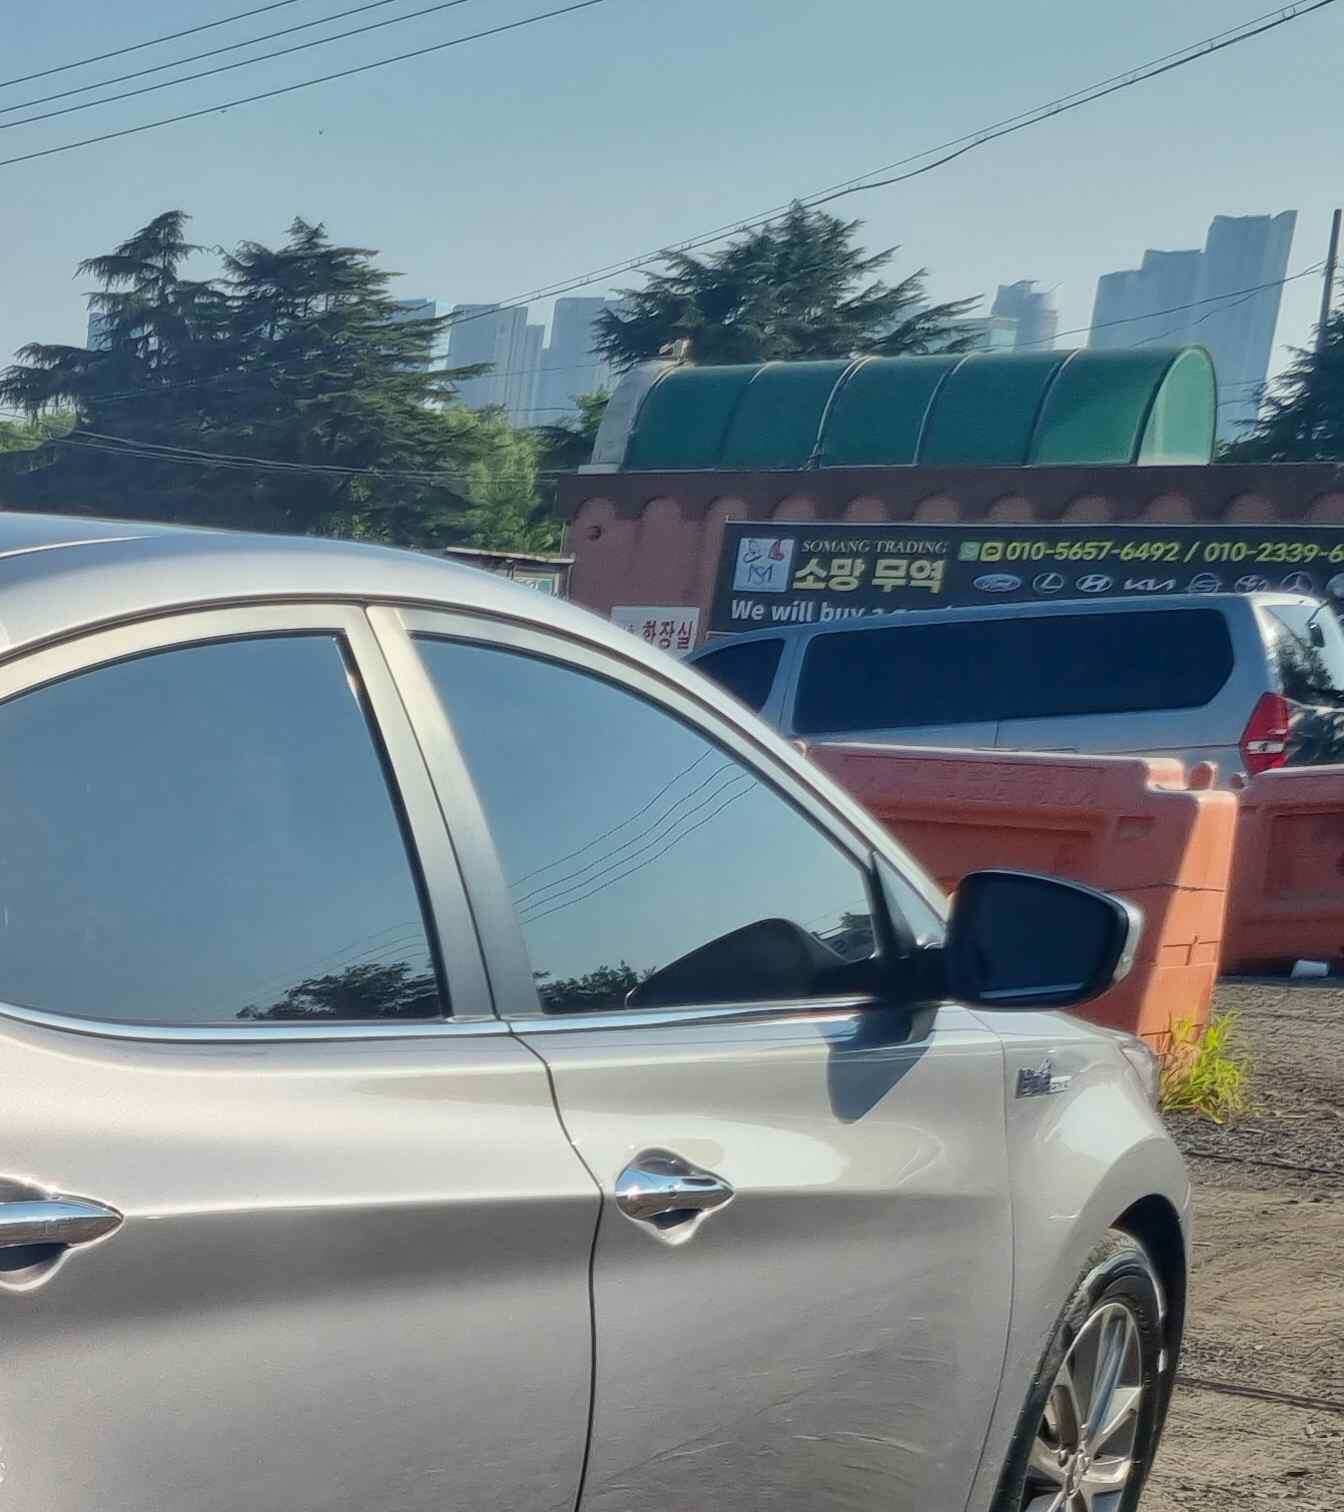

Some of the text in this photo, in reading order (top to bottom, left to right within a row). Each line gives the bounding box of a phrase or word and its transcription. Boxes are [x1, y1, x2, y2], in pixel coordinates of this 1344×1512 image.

[801, 539, 950, 554] SOMANG TRADING
[1006, 541, 1179, 562] 010-5657-6492
[792, 558, 865, 592] 소망
[871, 558, 945, 594] 무역
[731, 599, 765, 620] We
[771, 601, 813, 622] will
